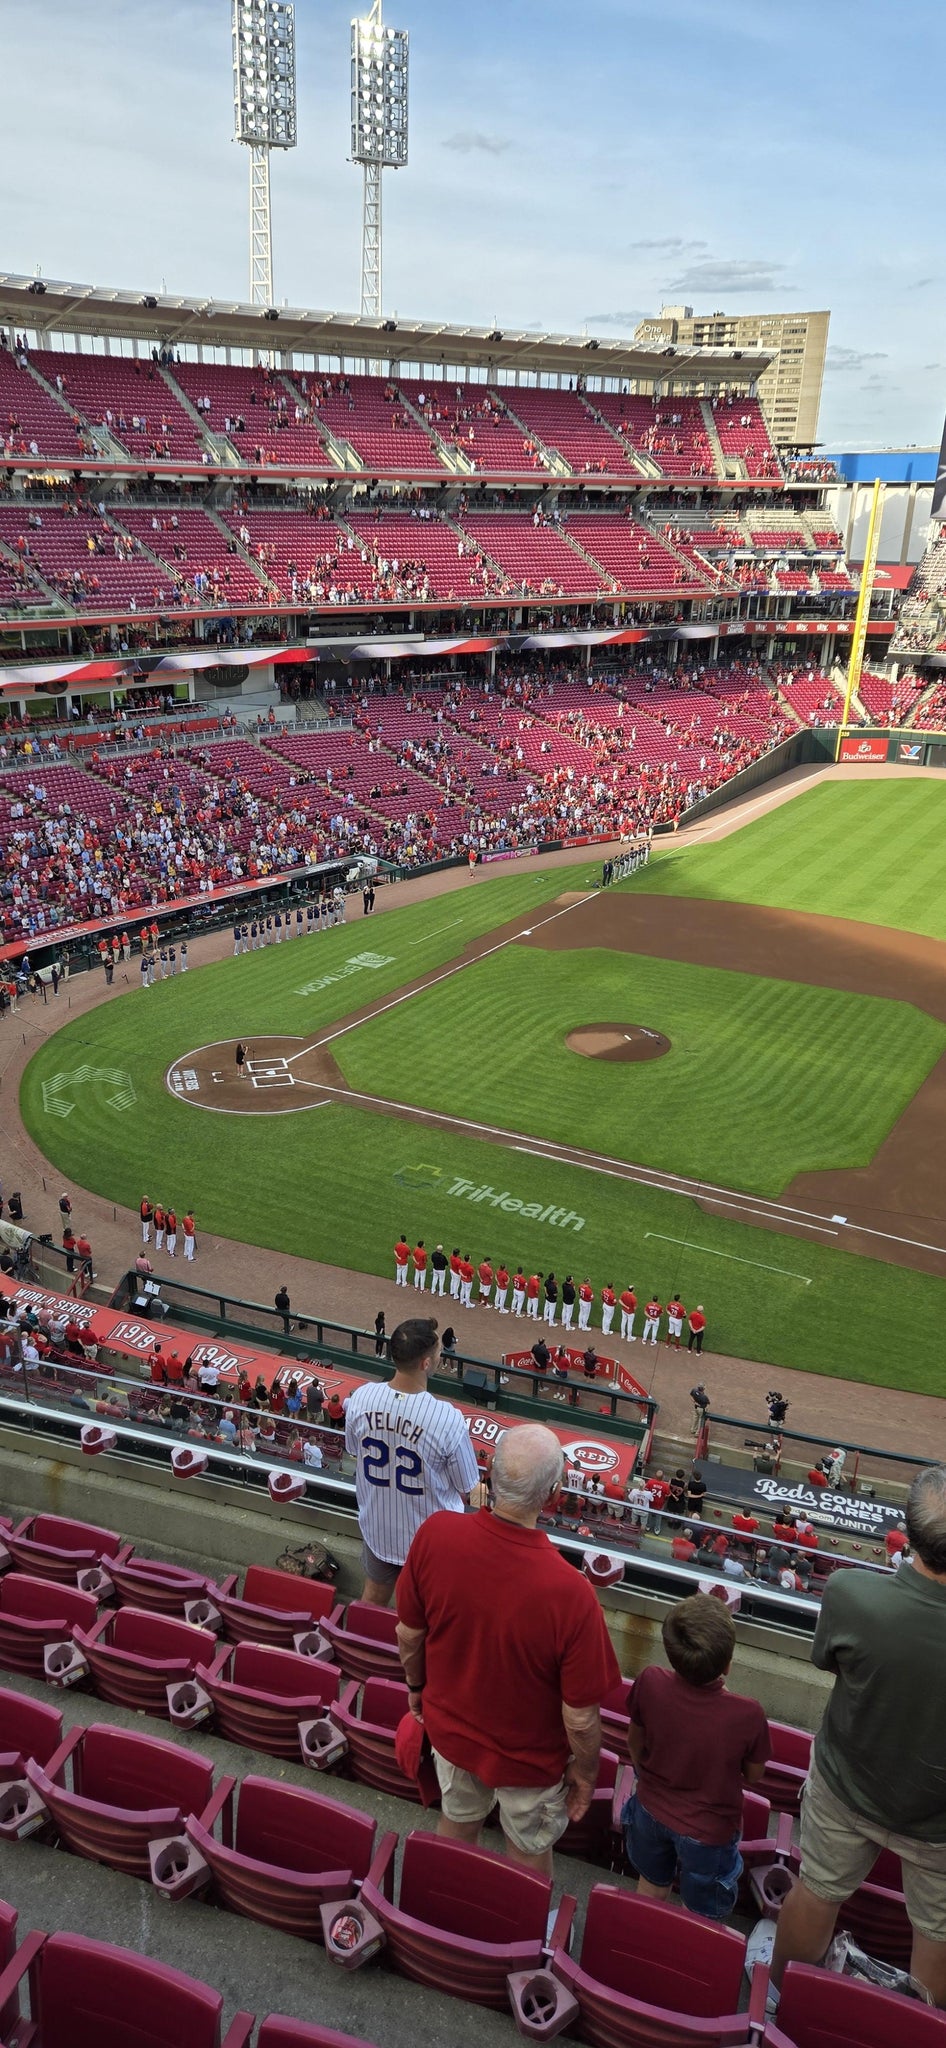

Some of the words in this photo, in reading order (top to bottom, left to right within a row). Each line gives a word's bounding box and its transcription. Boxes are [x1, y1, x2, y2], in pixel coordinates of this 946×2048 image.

[842, 752, 885, 761] Budweiser
[293, 964, 364, 997] BETMGM
[445, 1177, 587, 1231] TriHealth
[14, 1288, 57, 1306] WORLD
[53, 1299, 98, 1319] SERIES
[115, 1321, 157, 1349] 1919
[193, 1345, 239, 1372] 1940
[364, 1411, 424, 1445] YELICH
[361, 1436, 424, 1496] 22
[575, 1449, 617, 1465] REDS
[754, 1478, 818, 1507] Reds
[819, 1501, 884, 1523] CARES
